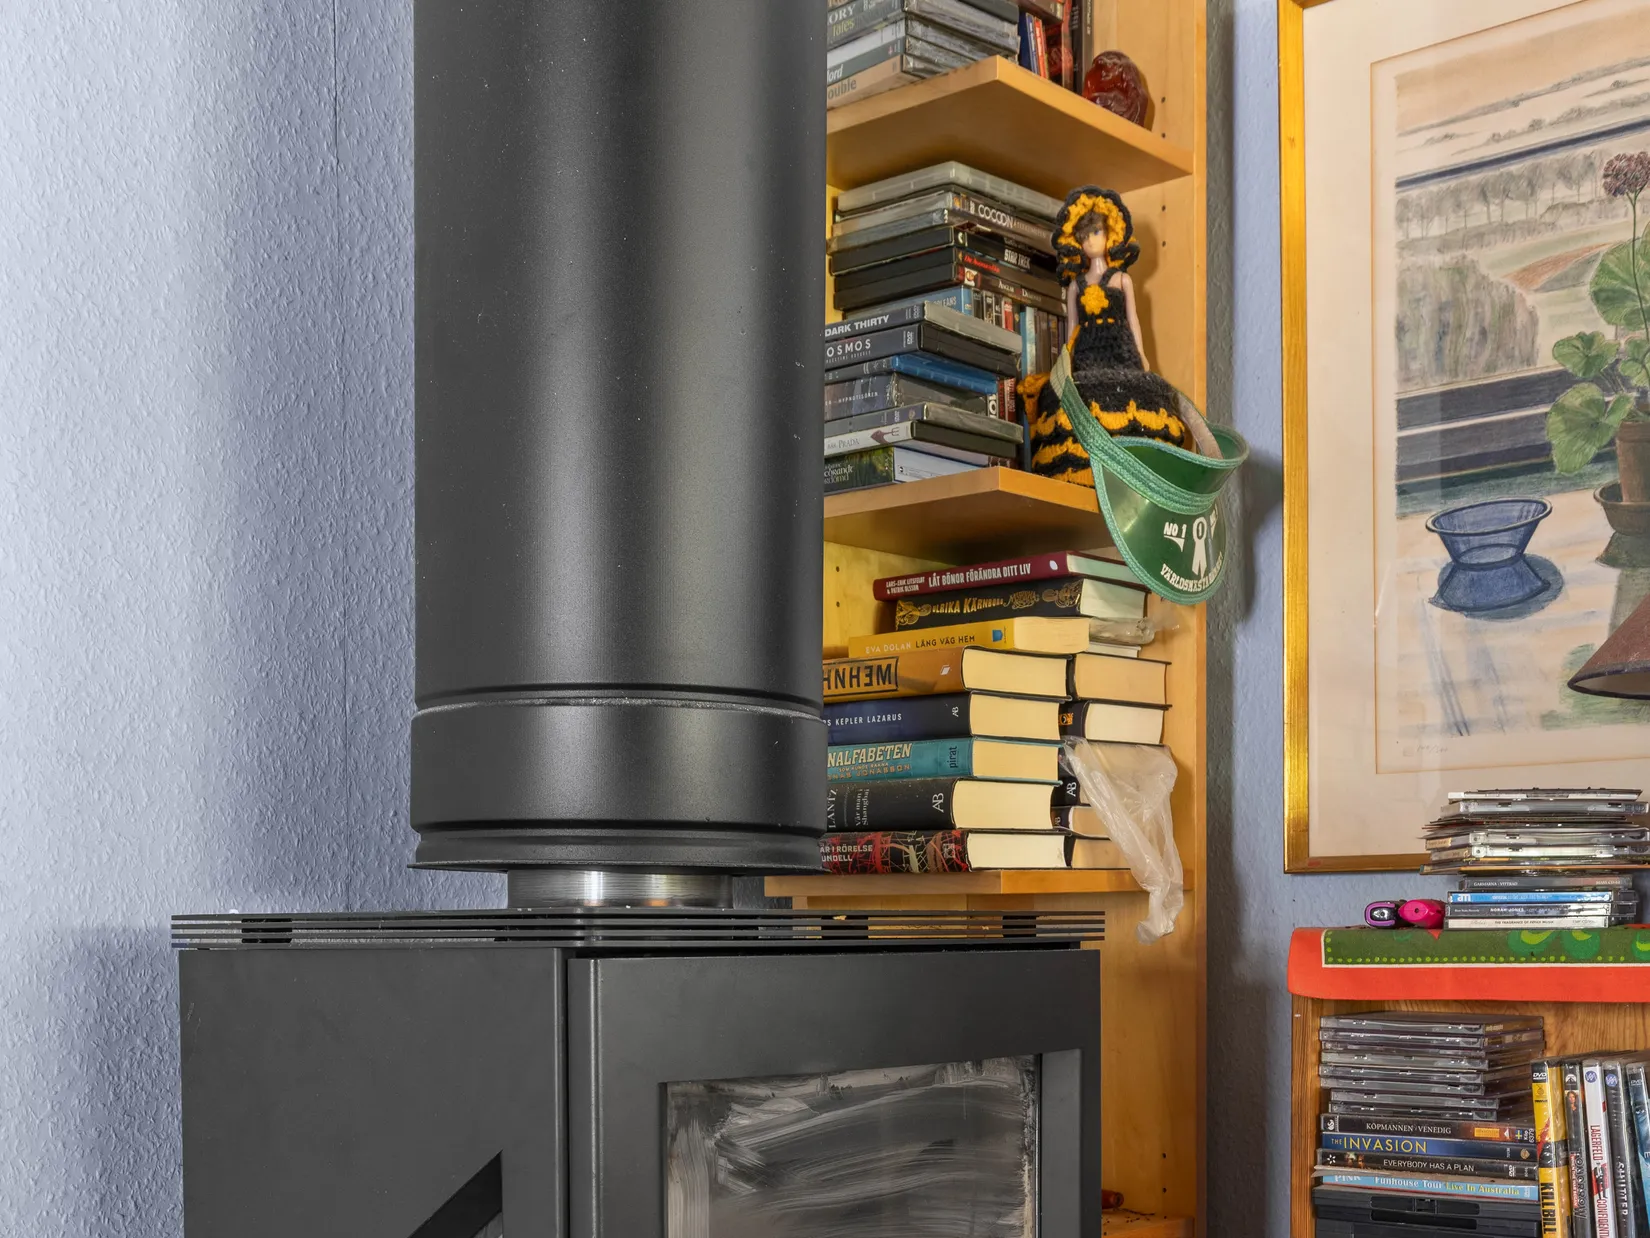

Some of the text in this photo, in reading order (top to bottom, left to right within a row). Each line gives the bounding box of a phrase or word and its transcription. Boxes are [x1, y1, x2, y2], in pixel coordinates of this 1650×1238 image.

[978, 204, 1013, 229] COCOON
[1004, 249, 1017, 265] STAR
[1018, 254, 1031, 269] TREK
[824, 315, 890, 337] DARK THIRTY
[826, 339, 871, 357] OSMOS
[1163, 522, 1187, 538] NO 1
[928, 563, 1031, 588] LÅT BÖNOR FÖRÄNDRA DITT LIV
[932, 601, 961, 614] ULRIKA
[865, 634, 976, 654] EVA DOLAN LÅNG VÄG HEM
[835, 712, 902, 726] KEPLER LAZARUS
[827, 743, 913, 768] NALFABETEN
[946, 746, 959, 769] pirat
[855, 764, 911, 778] JONASSON
[1066, 781, 1077, 797] AB
[827, 788, 838, 829] LANTZ
[932, 792, 945, 813] AB
[836, 843, 873, 853] RÖRELSE
[821, 854, 853, 862] UNDELL
[1366, 1121, 1451, 1134] KÖPMANNEN VENEDIG
[1343, 1137, 1427, 1153] INVASION
[1590, 1125, 1604, 1161] LAGERFELD
[1383, 1158, 1428, 1170] EVERYBODY
[1429, 1162, 1445, 1170] HAS
[1453, 1163, 1475, 1172] PLAN
[1374, 1176, 1419, 1188] Funhouse
[1422, 1178, 1443, 1189] Tour
[1445, 1182, 1464, 1191] Live
[1466, 1183, 1477, 1192] In
[1478, 1184, 1520, 1196] Australia
